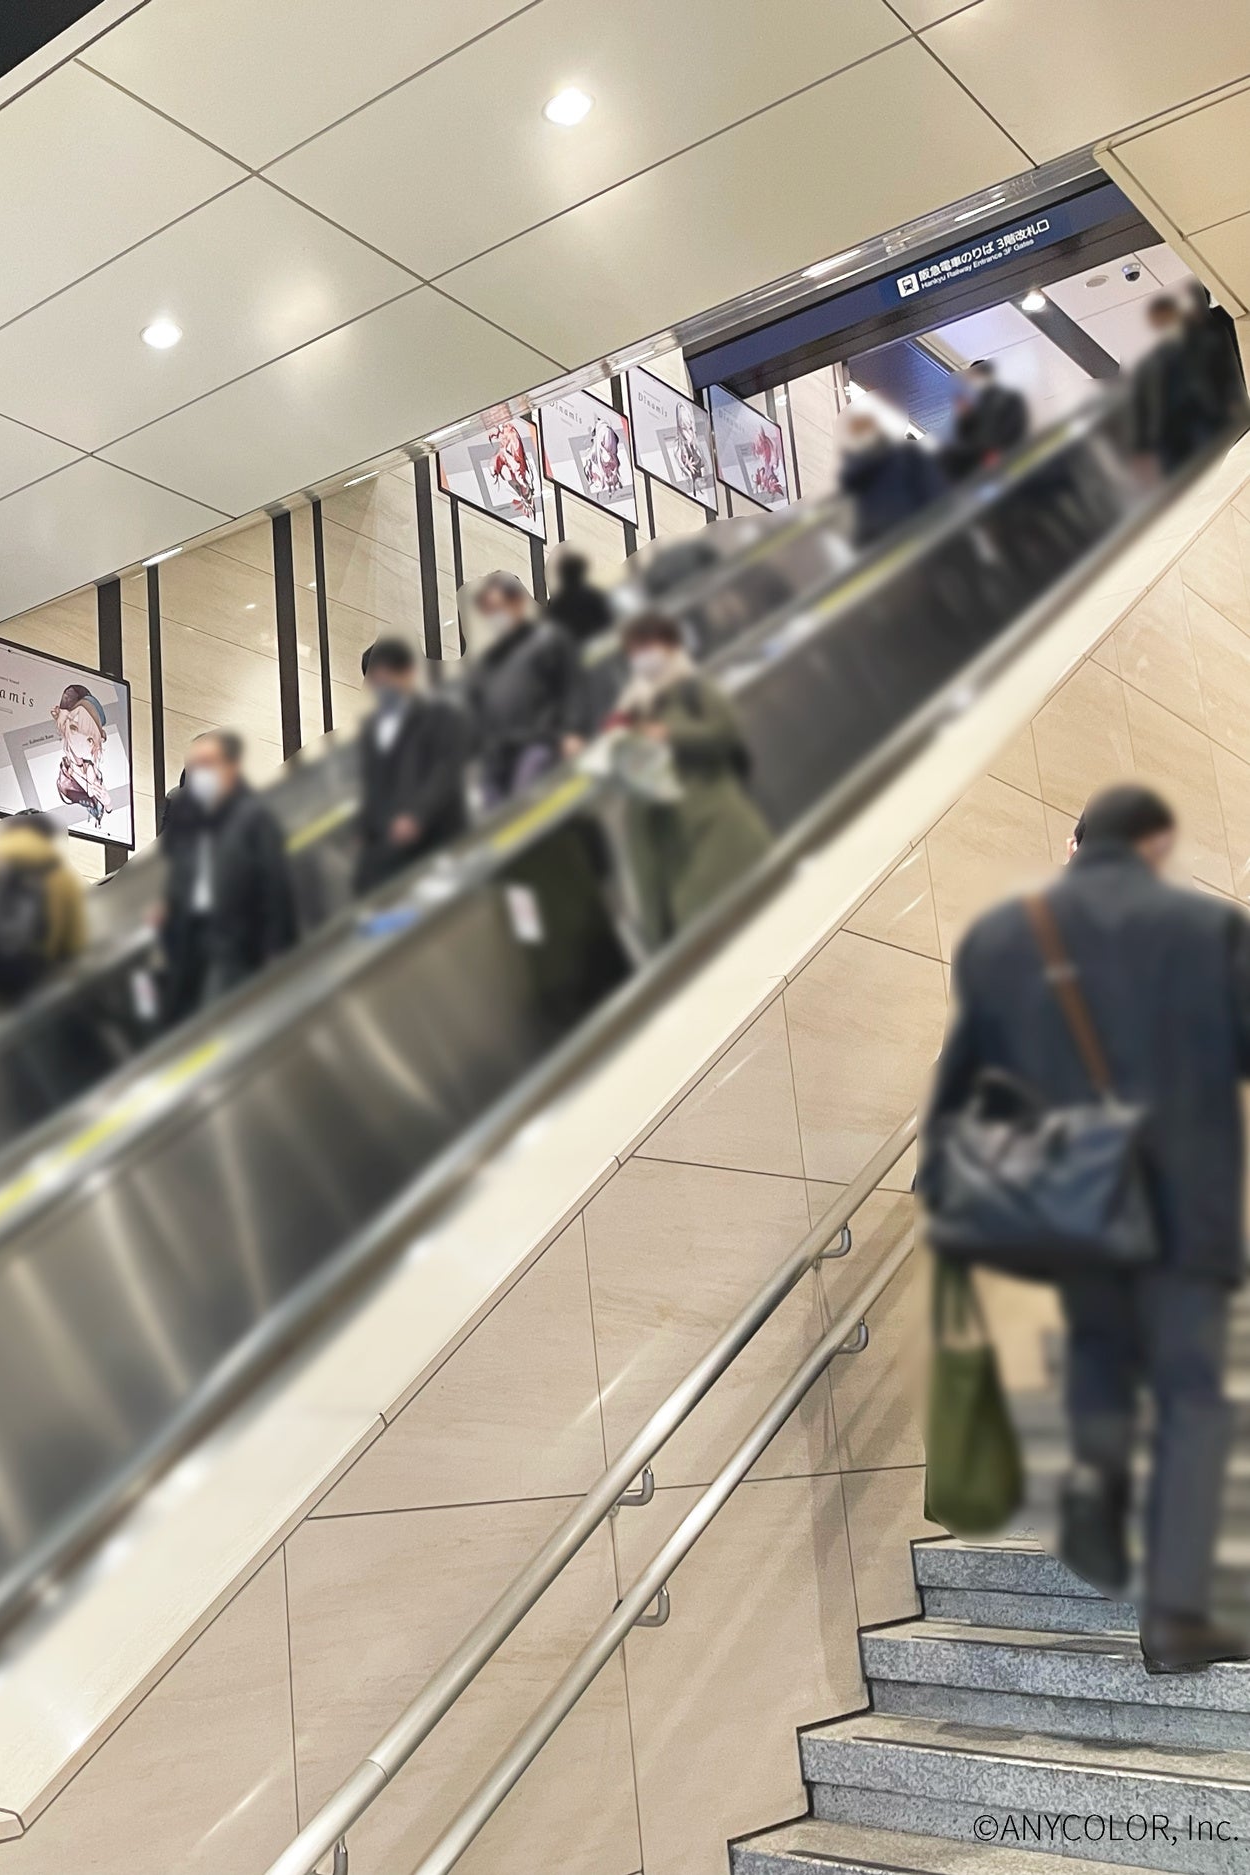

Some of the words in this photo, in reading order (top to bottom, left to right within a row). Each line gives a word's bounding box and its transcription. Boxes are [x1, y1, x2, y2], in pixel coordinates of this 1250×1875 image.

[918, 241, 994, 282] 阪急電車のりば
[997, 219, 1050, 250] 3階改札口
[921, 275, 946, 290] Hankyu
[947, 264, 972, 279] Railway
[973, 252, 1003, 268] Entrance
[1004, 248, 1012, 257] 3F
[1013, 239, 1035, 252] Gates
